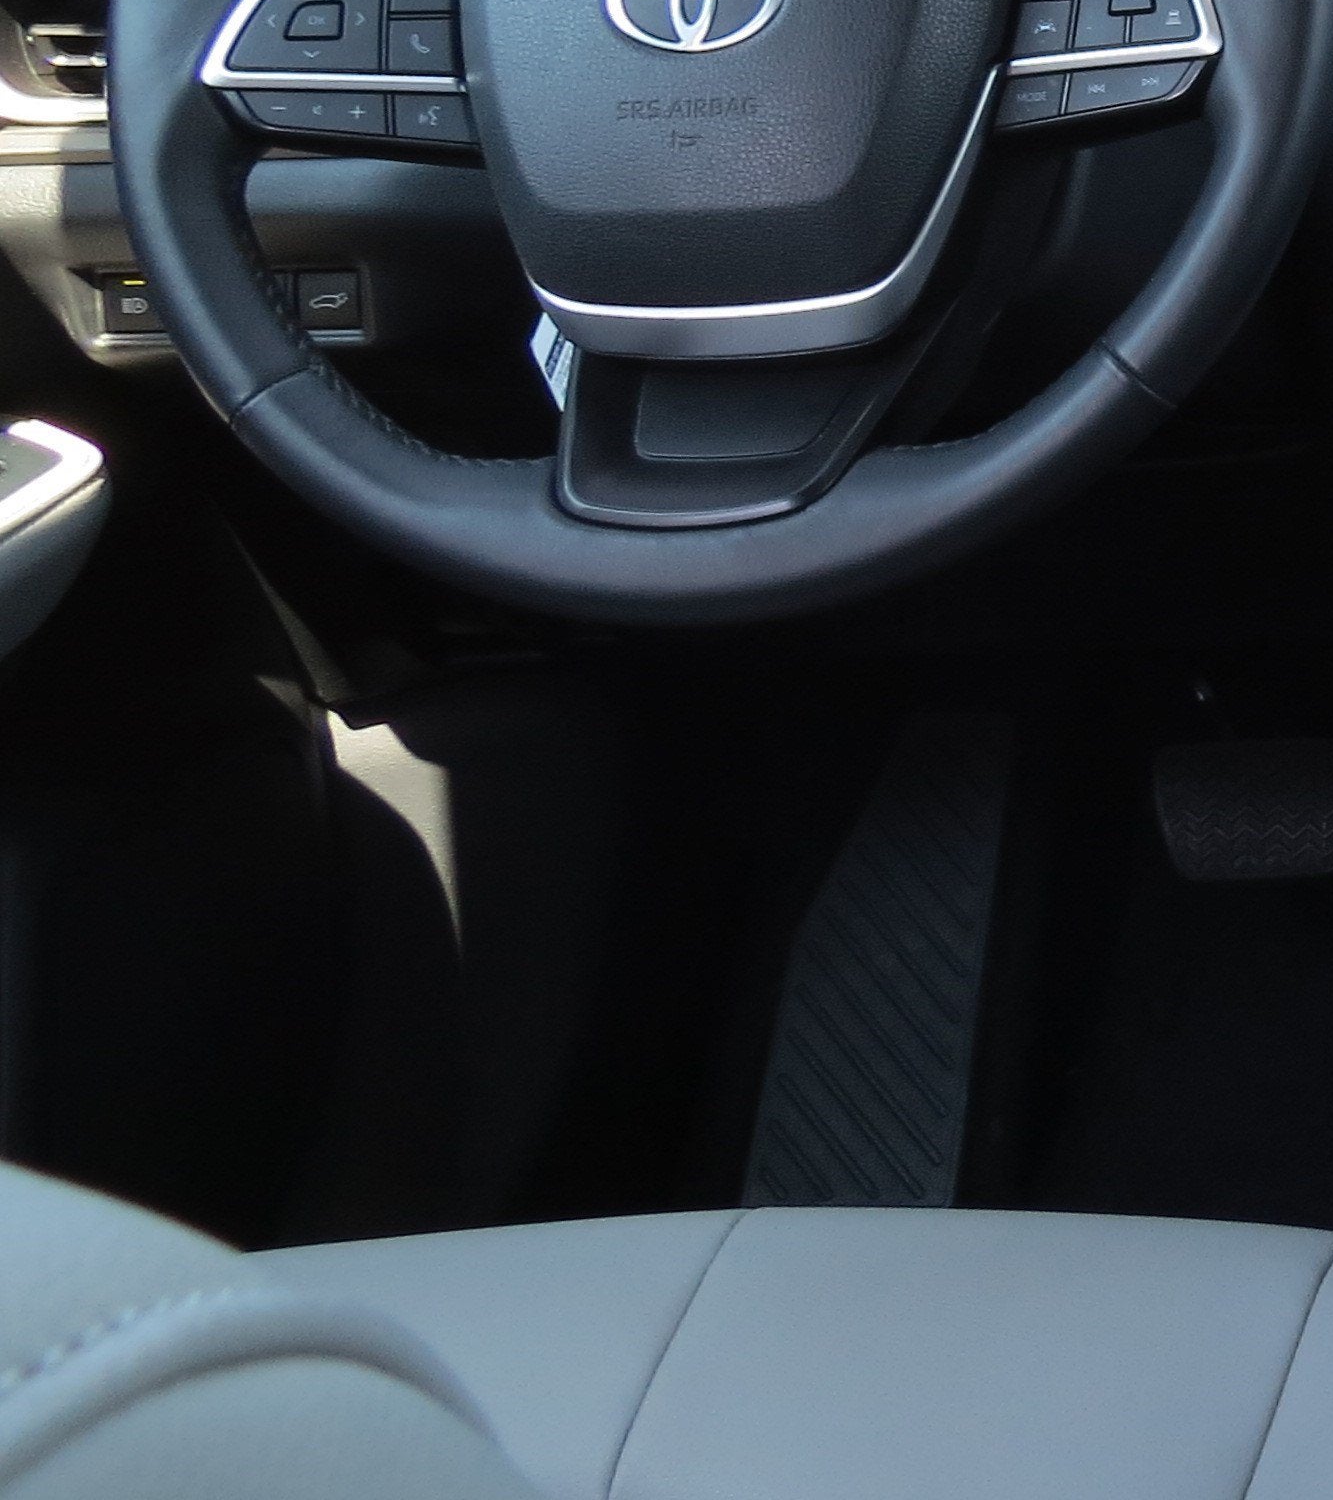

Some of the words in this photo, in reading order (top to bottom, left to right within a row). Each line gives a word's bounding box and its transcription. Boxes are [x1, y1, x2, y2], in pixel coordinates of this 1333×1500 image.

[308, 15, 327, 26] OK
[617, 100, 662, 120] SRS
[664, 97, 760, 119] AIRBAG
